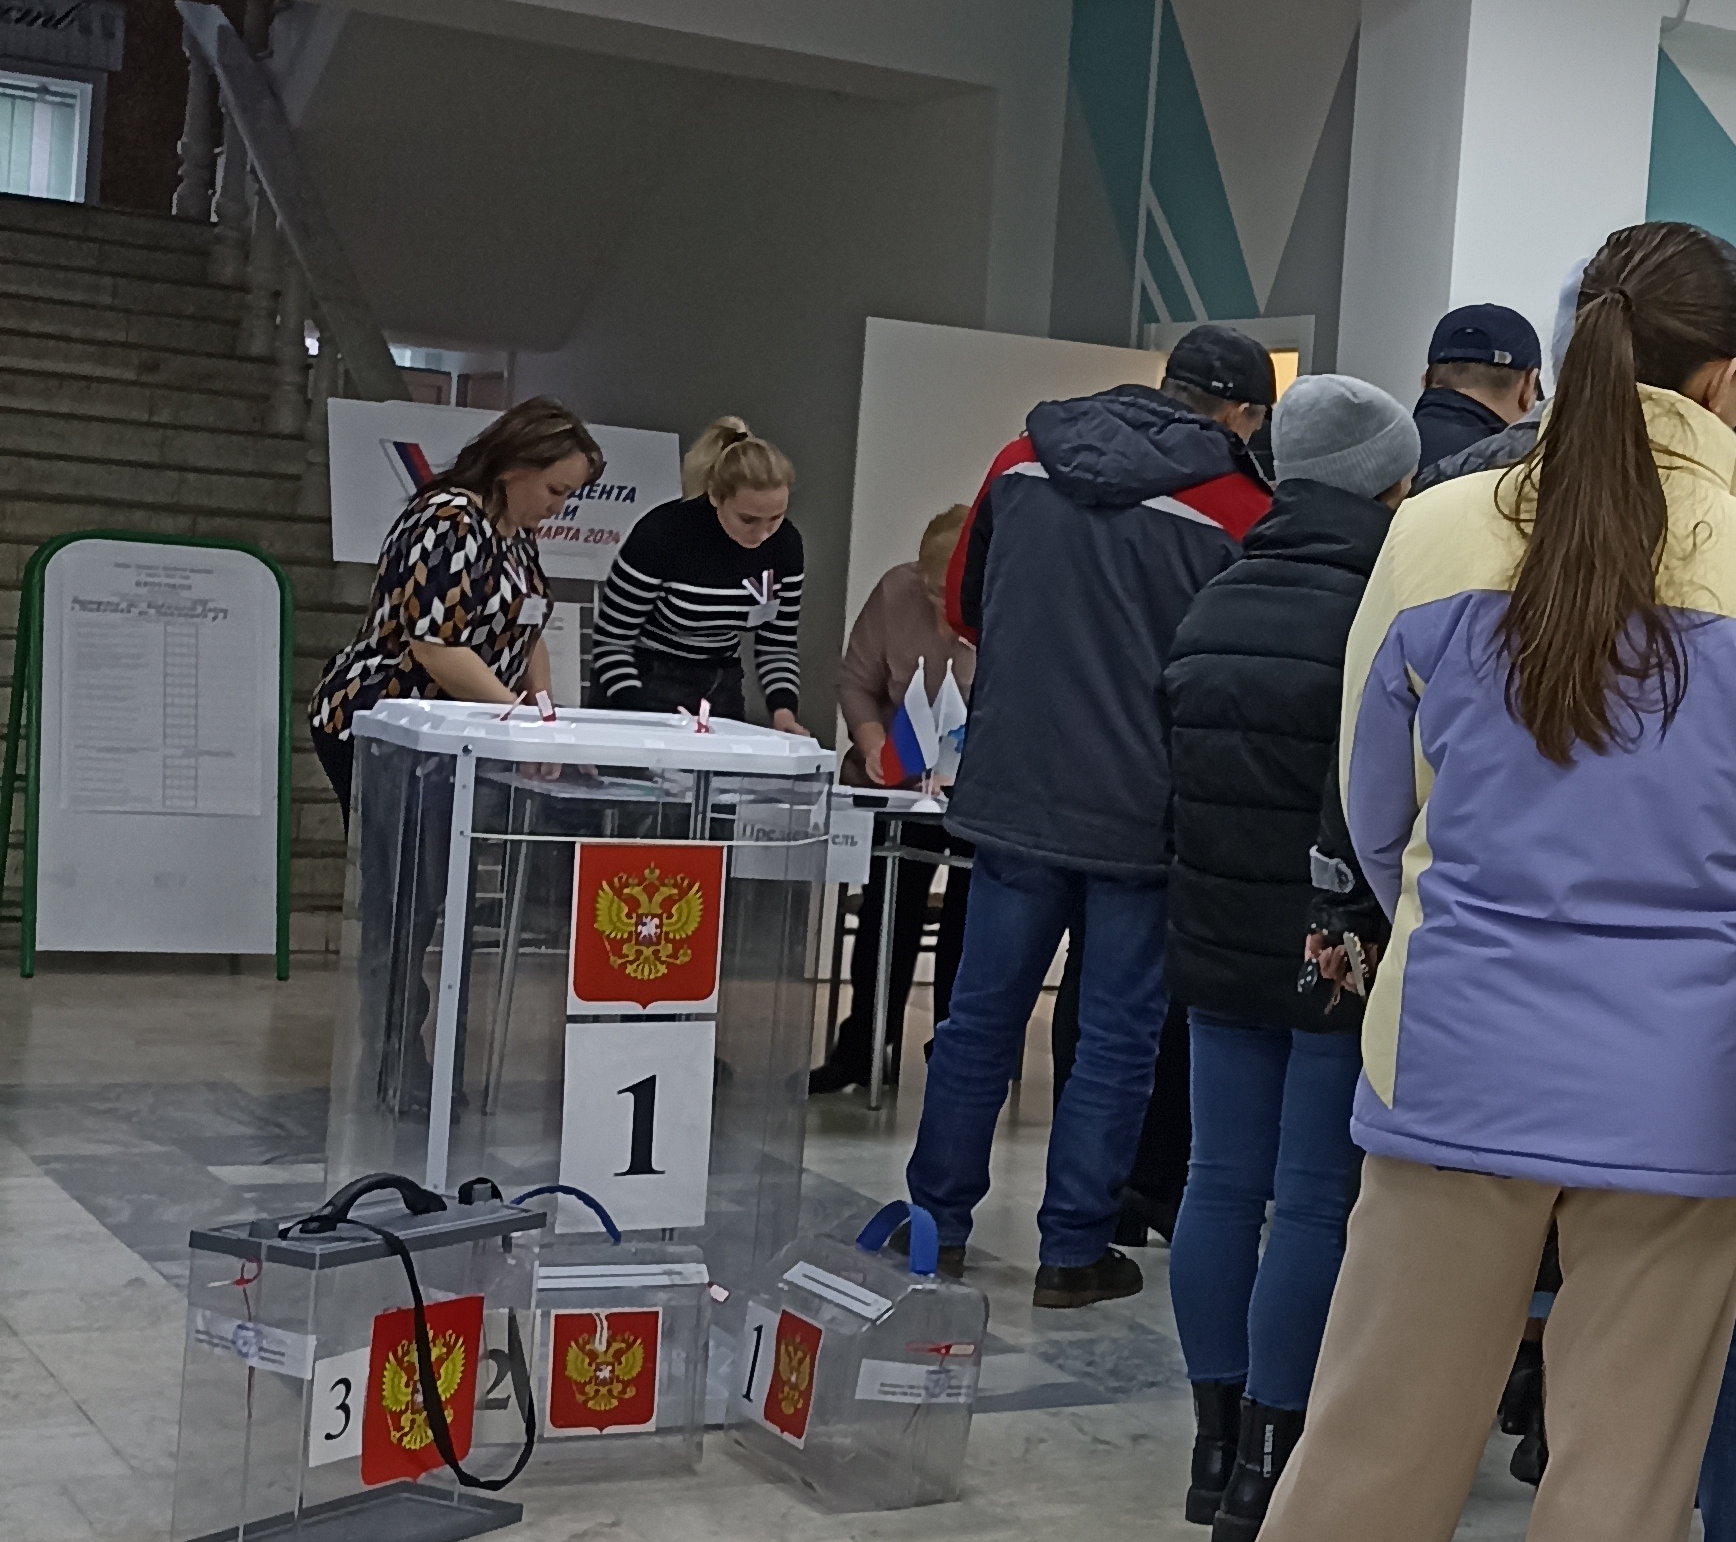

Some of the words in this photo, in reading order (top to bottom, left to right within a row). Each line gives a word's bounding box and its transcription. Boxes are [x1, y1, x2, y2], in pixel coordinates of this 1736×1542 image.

[567, 482, 637, 504] ДЕНТА
[613, 1074, 666, 1176] 1
[743, 1325, 764, 1403] 1
[324, 1377, 352, 1441] 3
